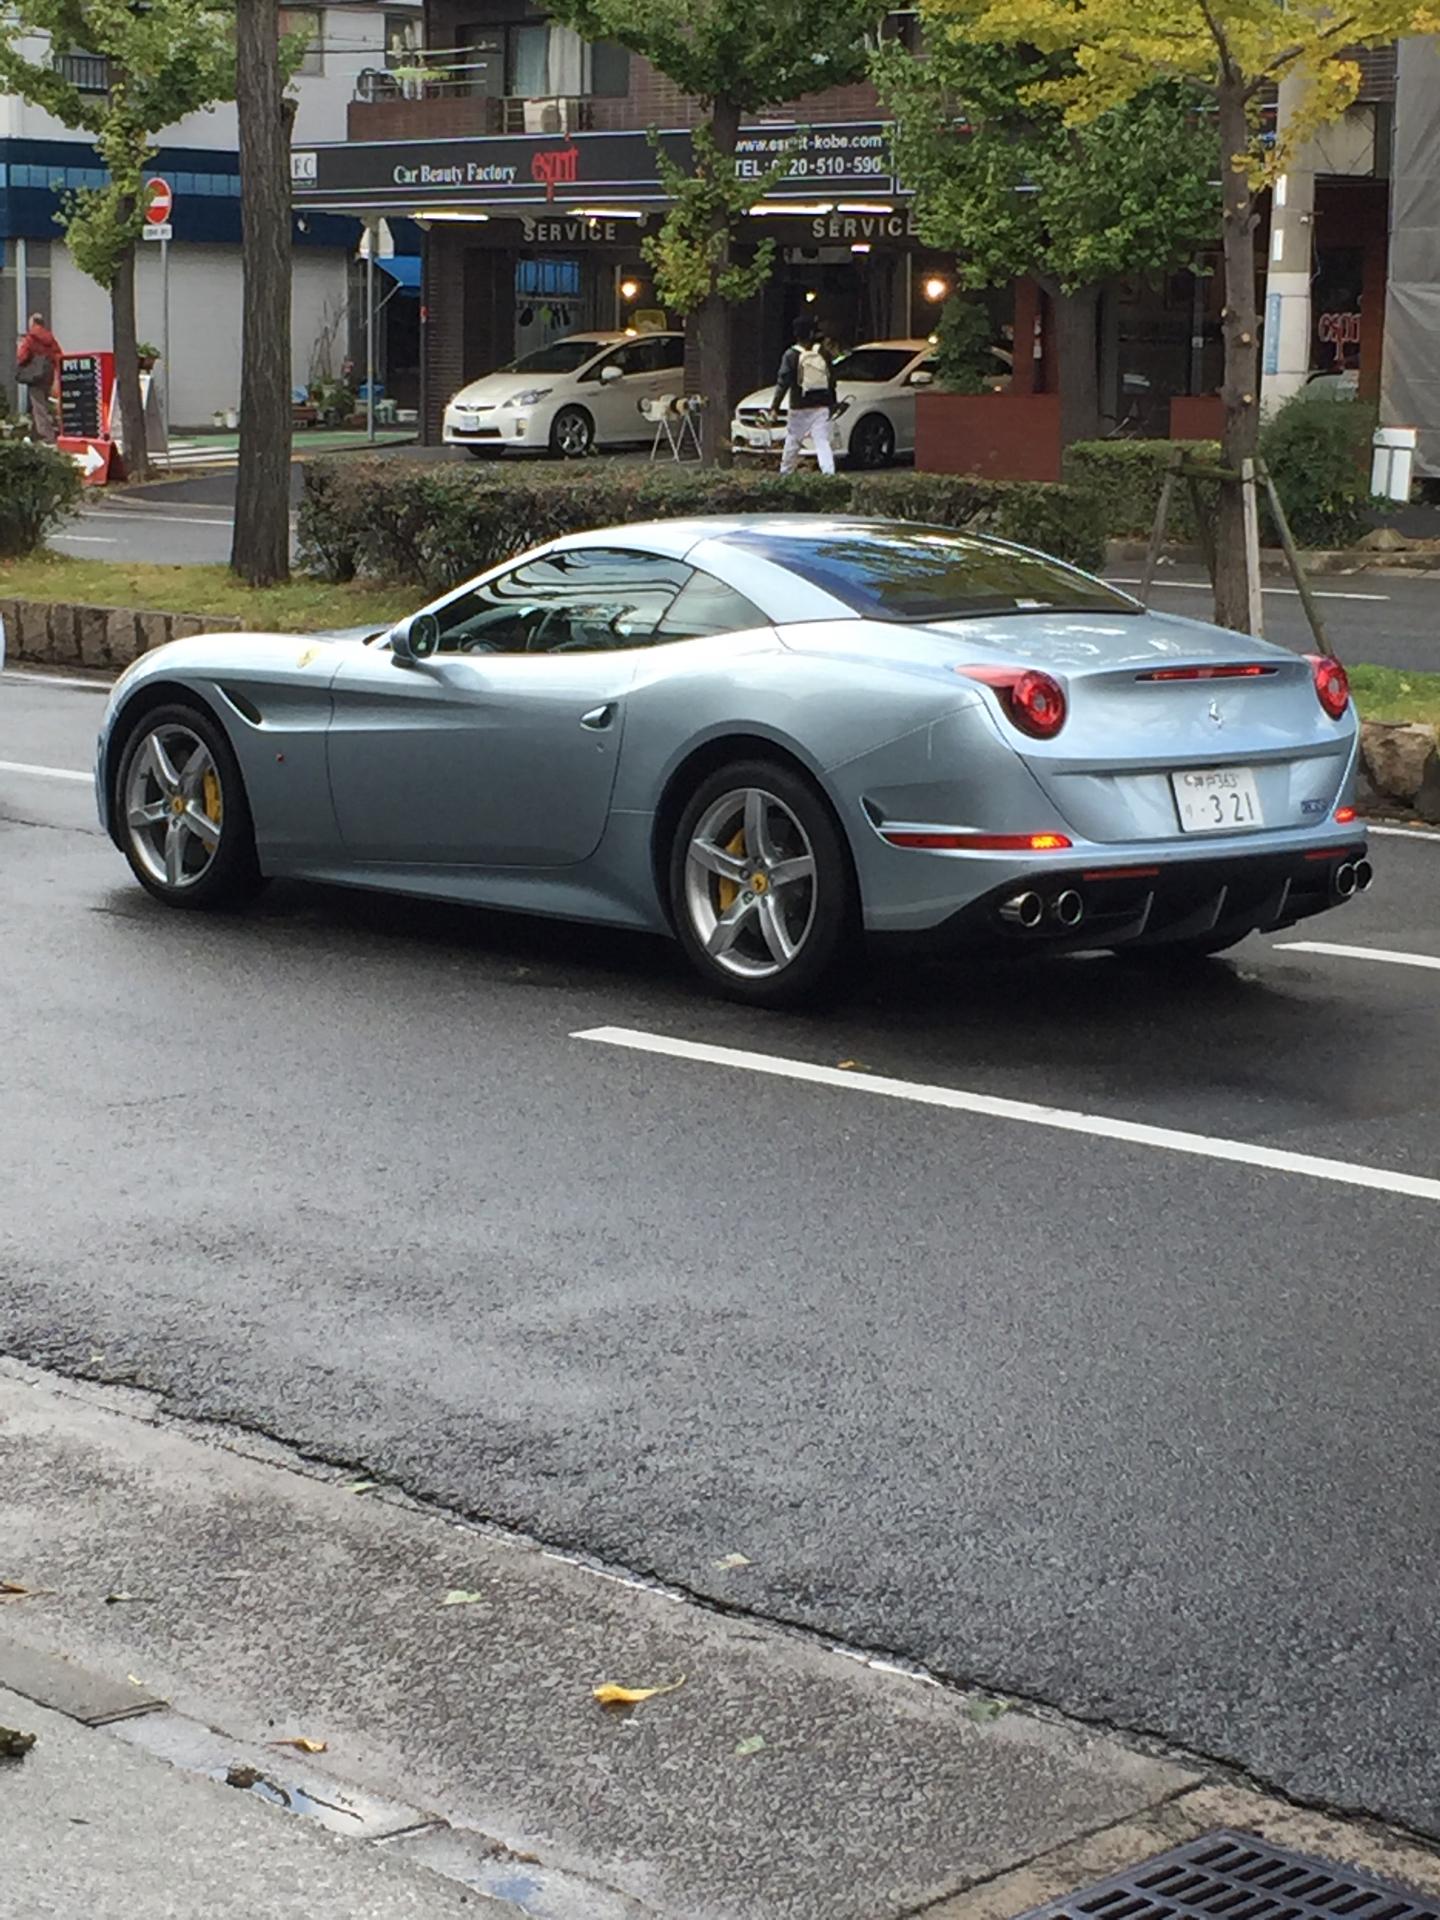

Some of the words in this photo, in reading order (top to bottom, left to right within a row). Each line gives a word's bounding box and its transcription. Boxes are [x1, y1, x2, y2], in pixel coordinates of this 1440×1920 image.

[734, 134, 882, 152] www.esit-kobe.com
[393, 165, 419, 184] Car
[420, 164, 465, 186] Beauty
[466, 162, 517, 185] Factory
[523, 222, 616, 241] SERVICE
[812, 216, 920, 239] SERVICE
